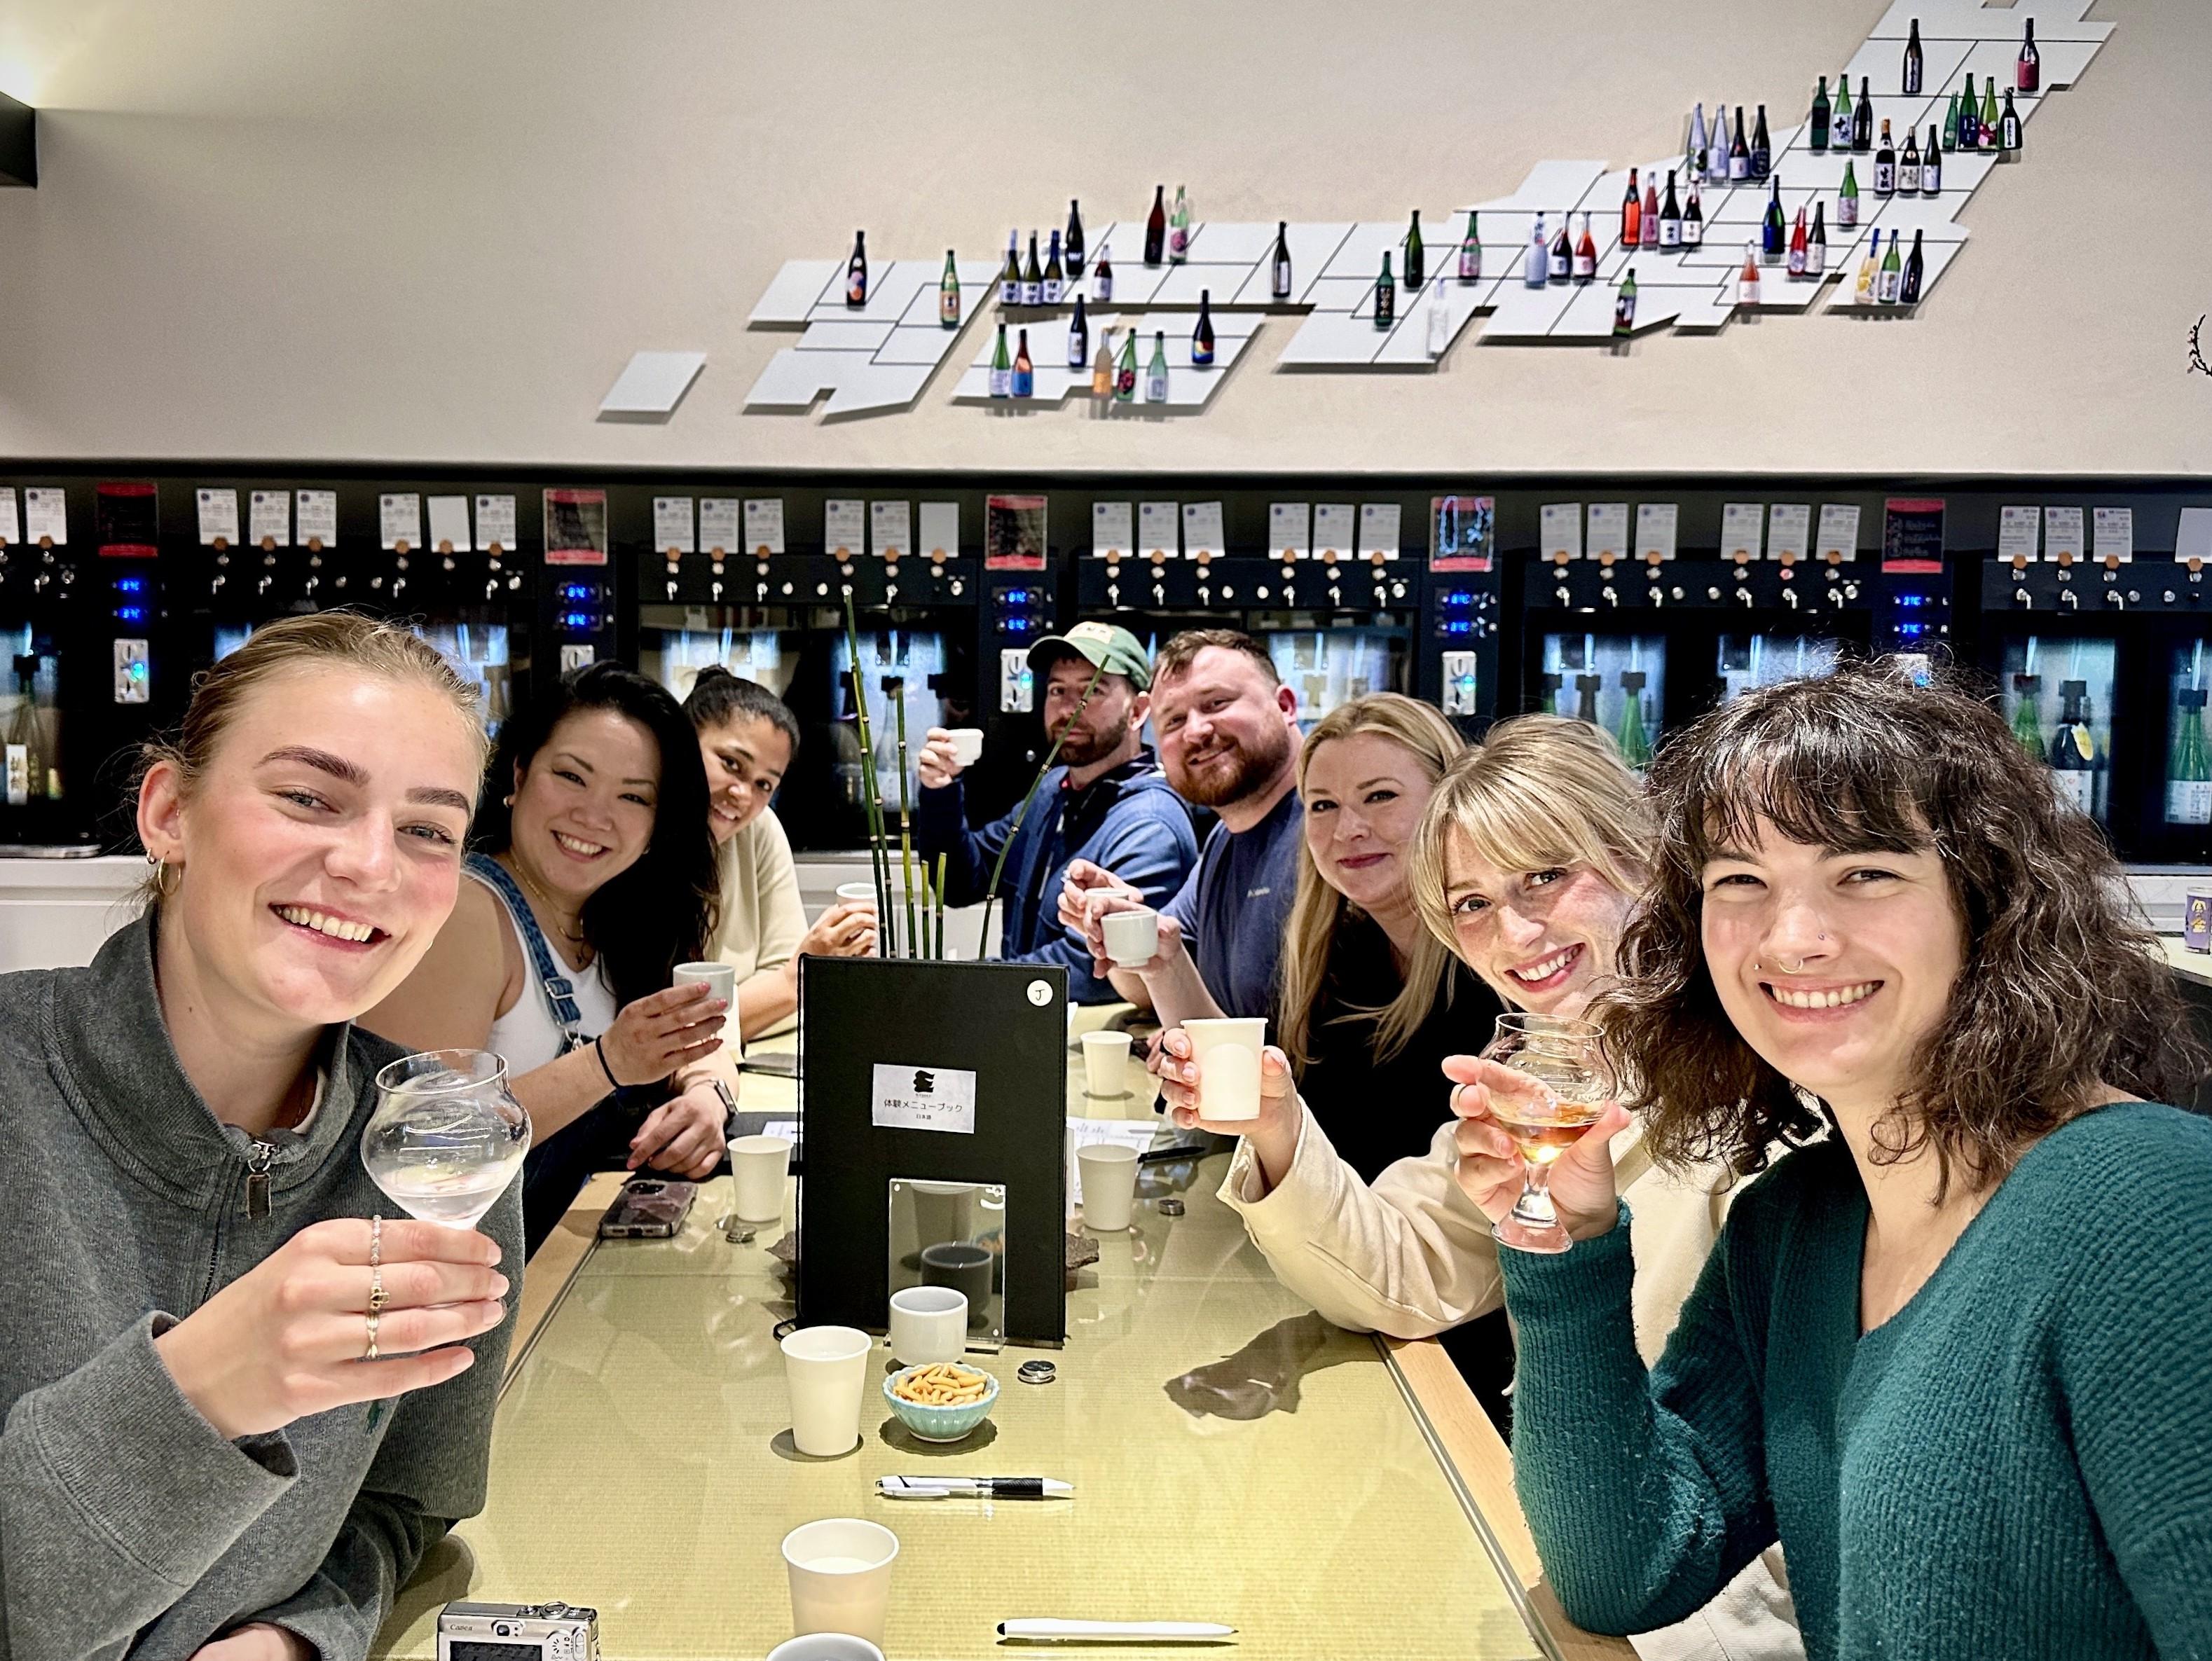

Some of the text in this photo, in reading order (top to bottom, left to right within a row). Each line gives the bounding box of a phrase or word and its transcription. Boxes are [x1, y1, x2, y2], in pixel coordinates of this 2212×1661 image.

[1035, 988, 1045, 1001] J
[884, 1098, 963, 1112] 体験メニューブック
